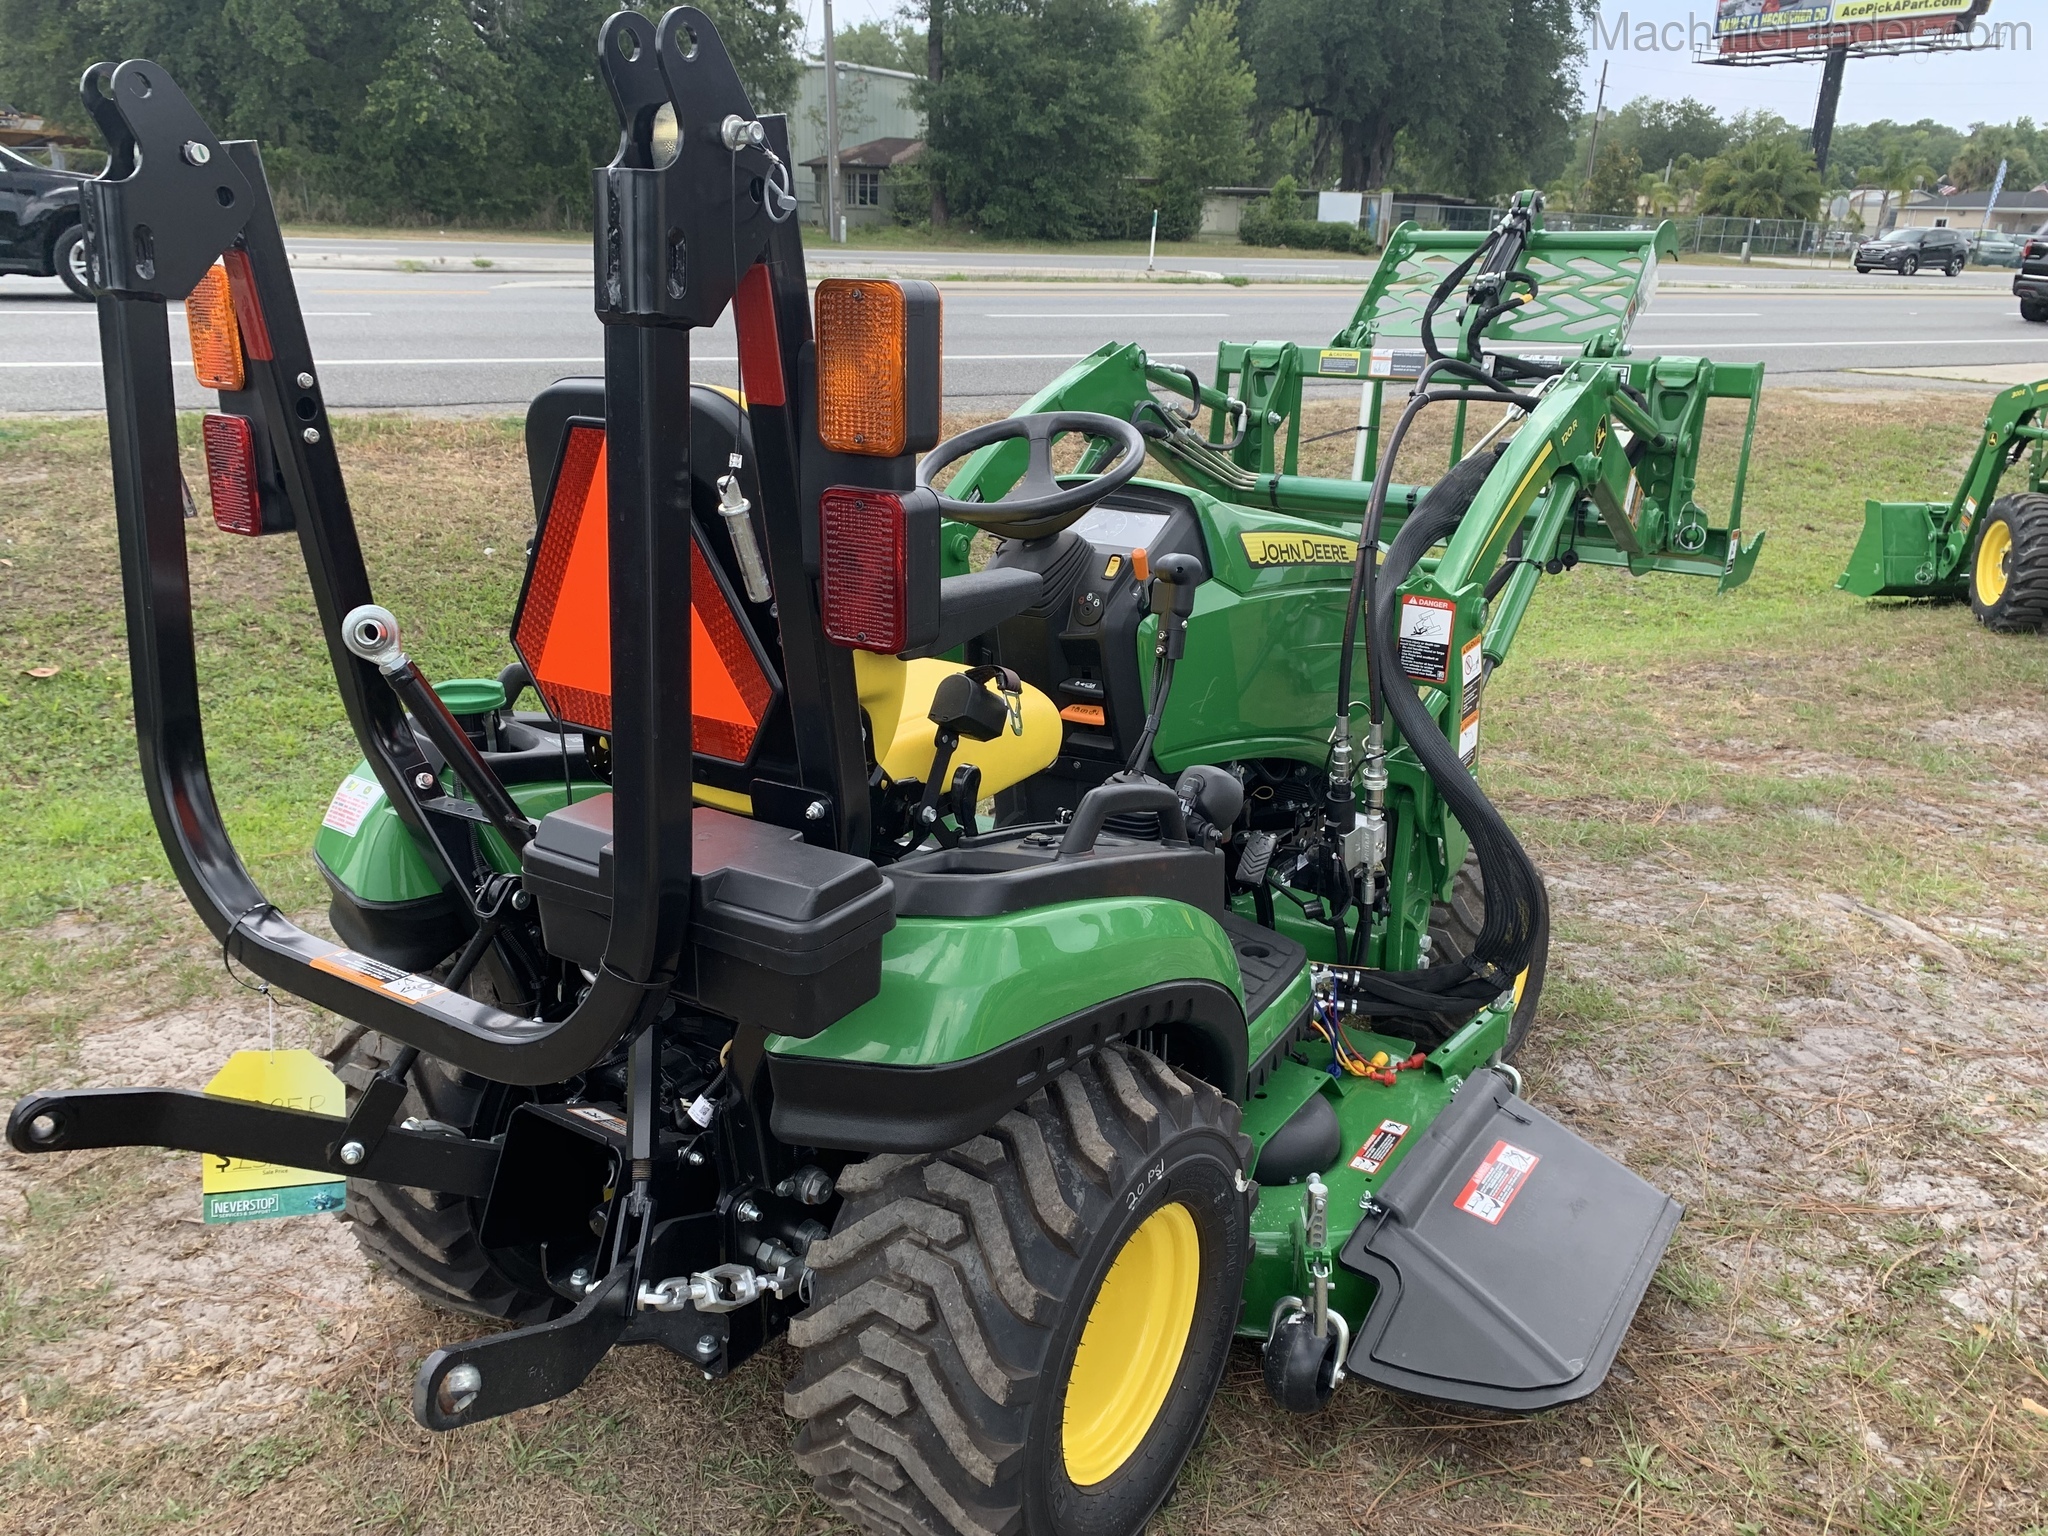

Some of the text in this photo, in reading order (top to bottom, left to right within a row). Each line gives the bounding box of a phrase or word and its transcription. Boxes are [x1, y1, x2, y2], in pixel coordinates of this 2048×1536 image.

[1741, 16, 1752, 29] ST
[1814, 7, 1828, 21] DR
[1841, 0, 1962, 17] AcePickAPart.com
[1260, 540, 1349, 562] JOHN DEERE
[1418, 598, 1448, 609] DANGER
[1125, 1182, 1145, 1210] 20
[214, 1198, 276, 1215] NEVERSTOP
